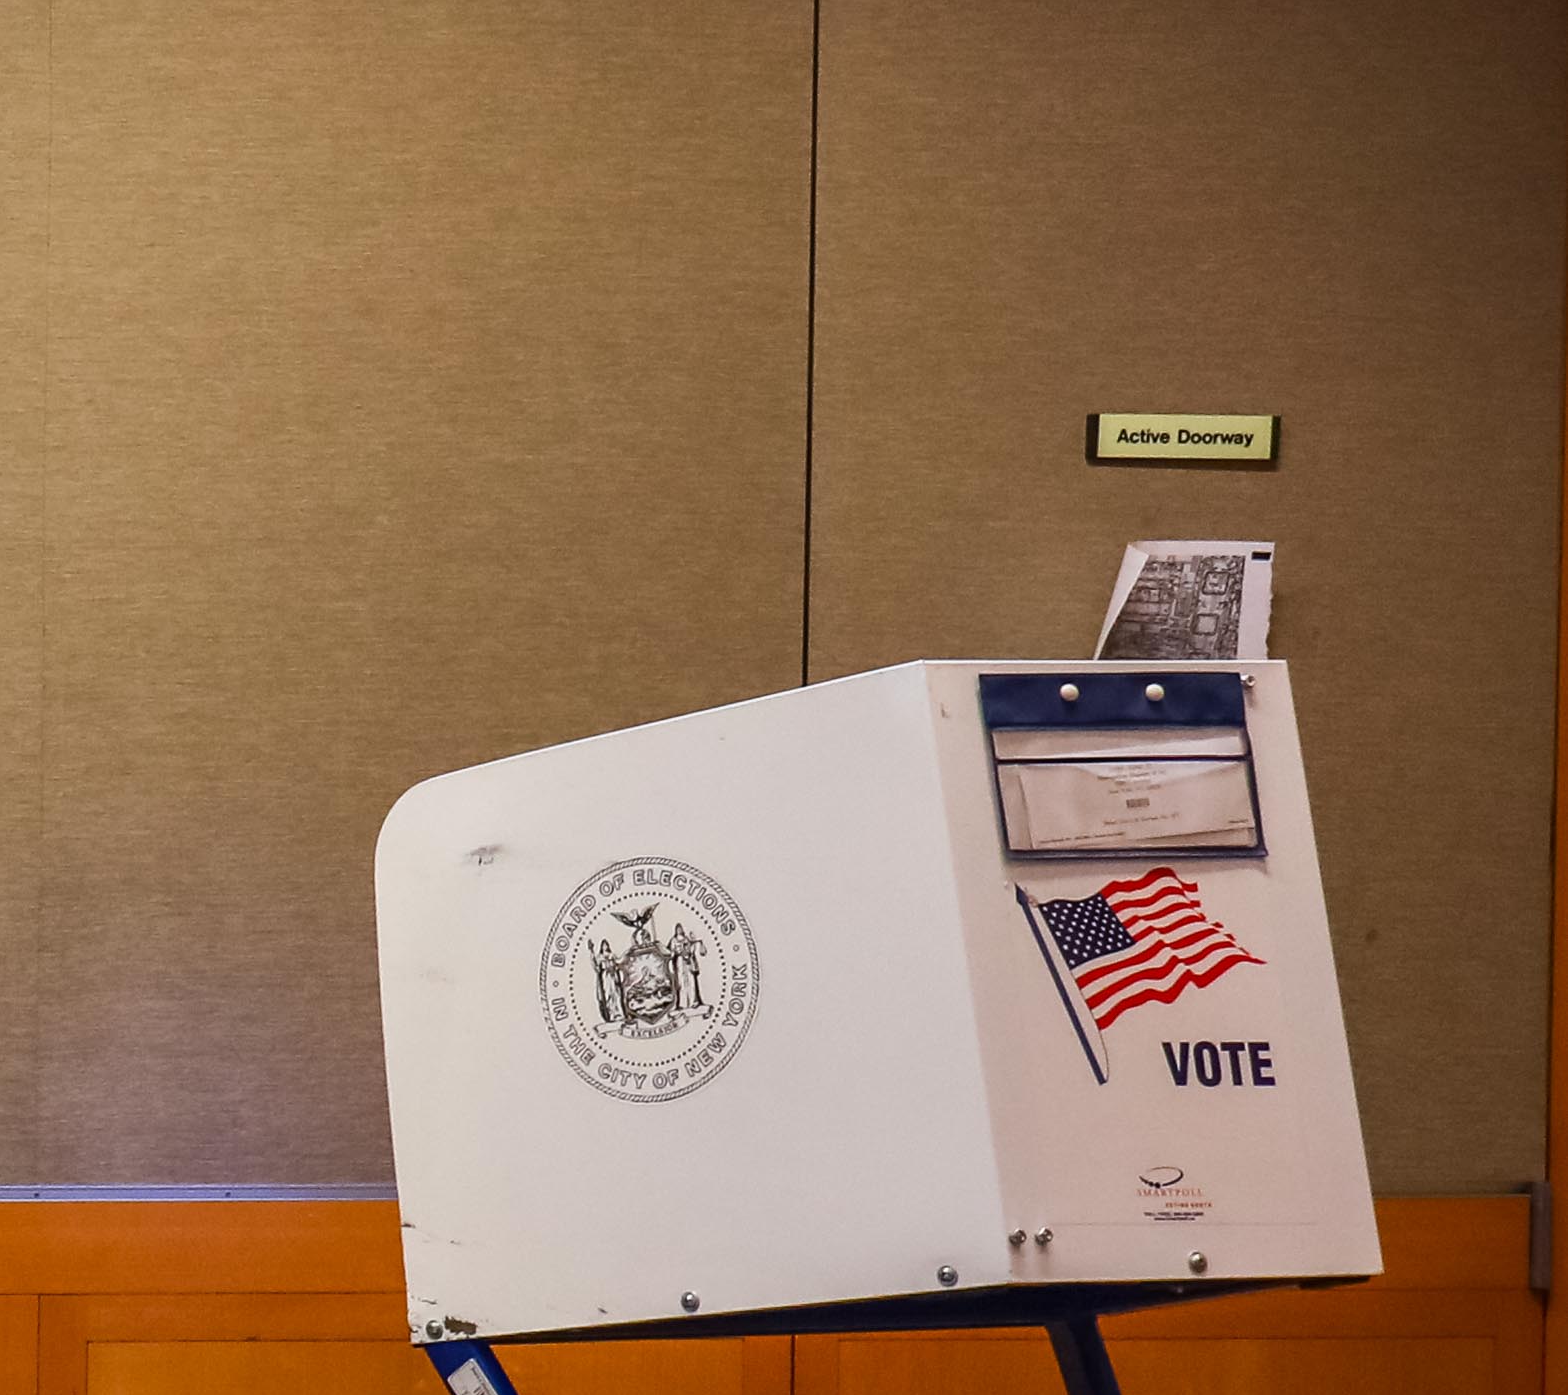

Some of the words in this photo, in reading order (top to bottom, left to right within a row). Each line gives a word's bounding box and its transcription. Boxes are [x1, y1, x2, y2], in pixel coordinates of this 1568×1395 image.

[1117, 428, 1170, 444] Active
[1177, 428, 1254, 448] Doorway
[551, 894, 597, 967] BOARD
[599, 873, 624, 897] OF
[633, 869, 736, 936] ELECTIONS
[552, 997, 569, 1022] IN
[563, 1024, 595, 1066] THE
[598, 1062, 647, 1089] CITY
[652, 1069, 680, 1089] OF
[684, 1032, 727, 1078] NEW
[722, 963, 748, 1029] YORK
[1161, 1041, 1276, 1087] VOTE
